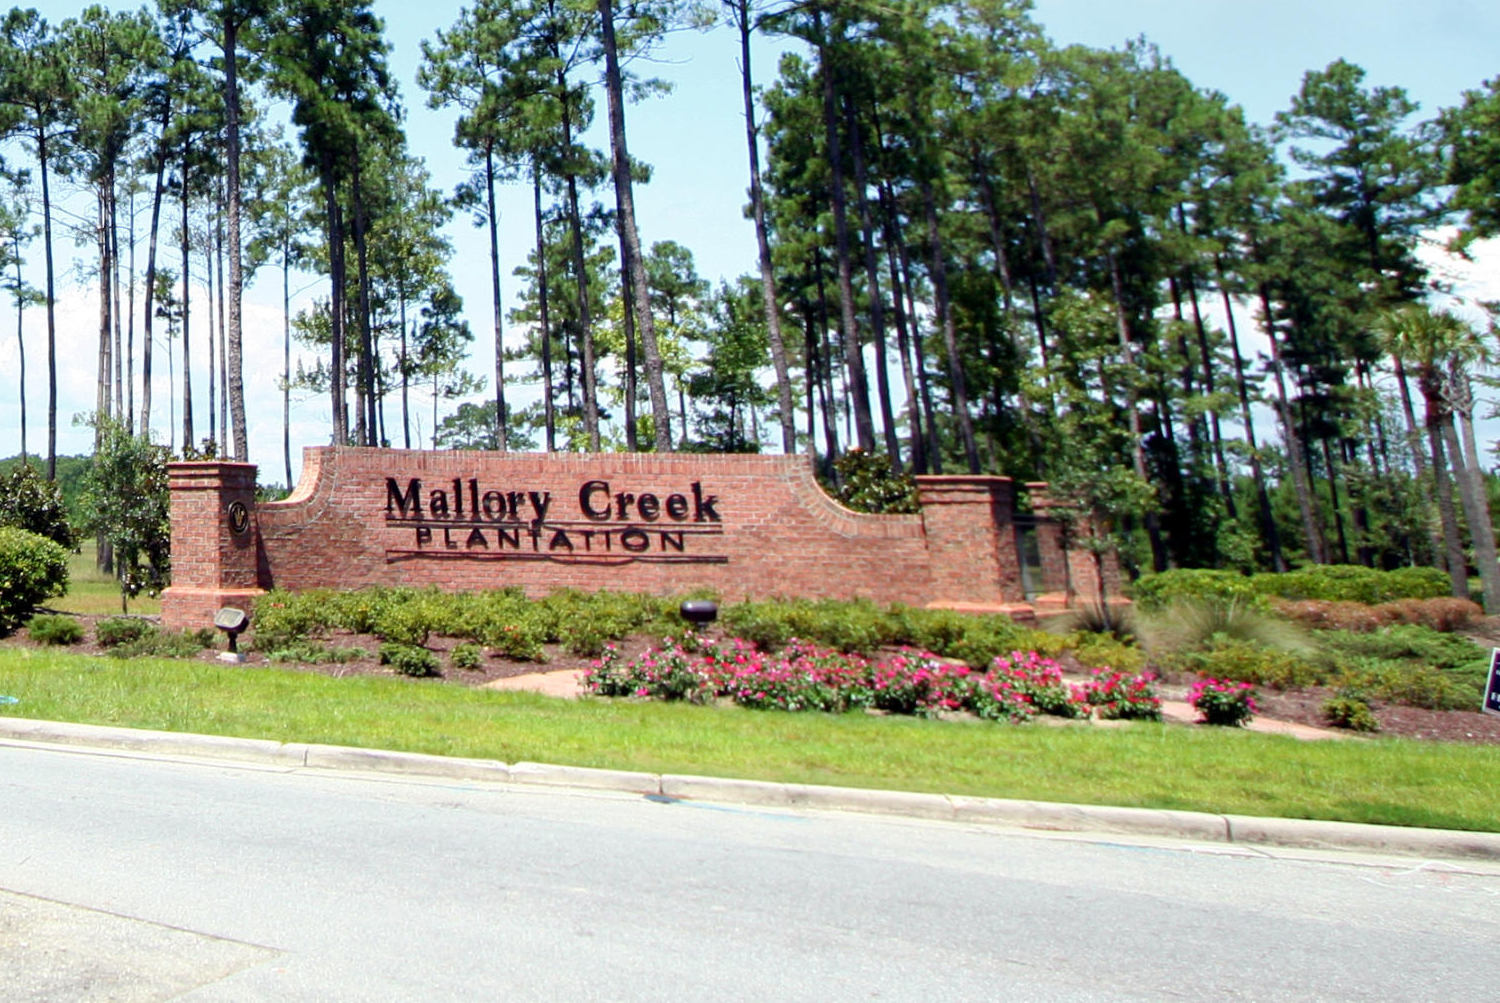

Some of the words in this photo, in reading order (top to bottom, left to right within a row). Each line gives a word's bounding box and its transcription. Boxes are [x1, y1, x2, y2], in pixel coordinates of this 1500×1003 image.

[385, 477, 550, 526] Mallory
[579, 480, 722, 523] Creek
[416, 527, 685, 552] PLANTATION
